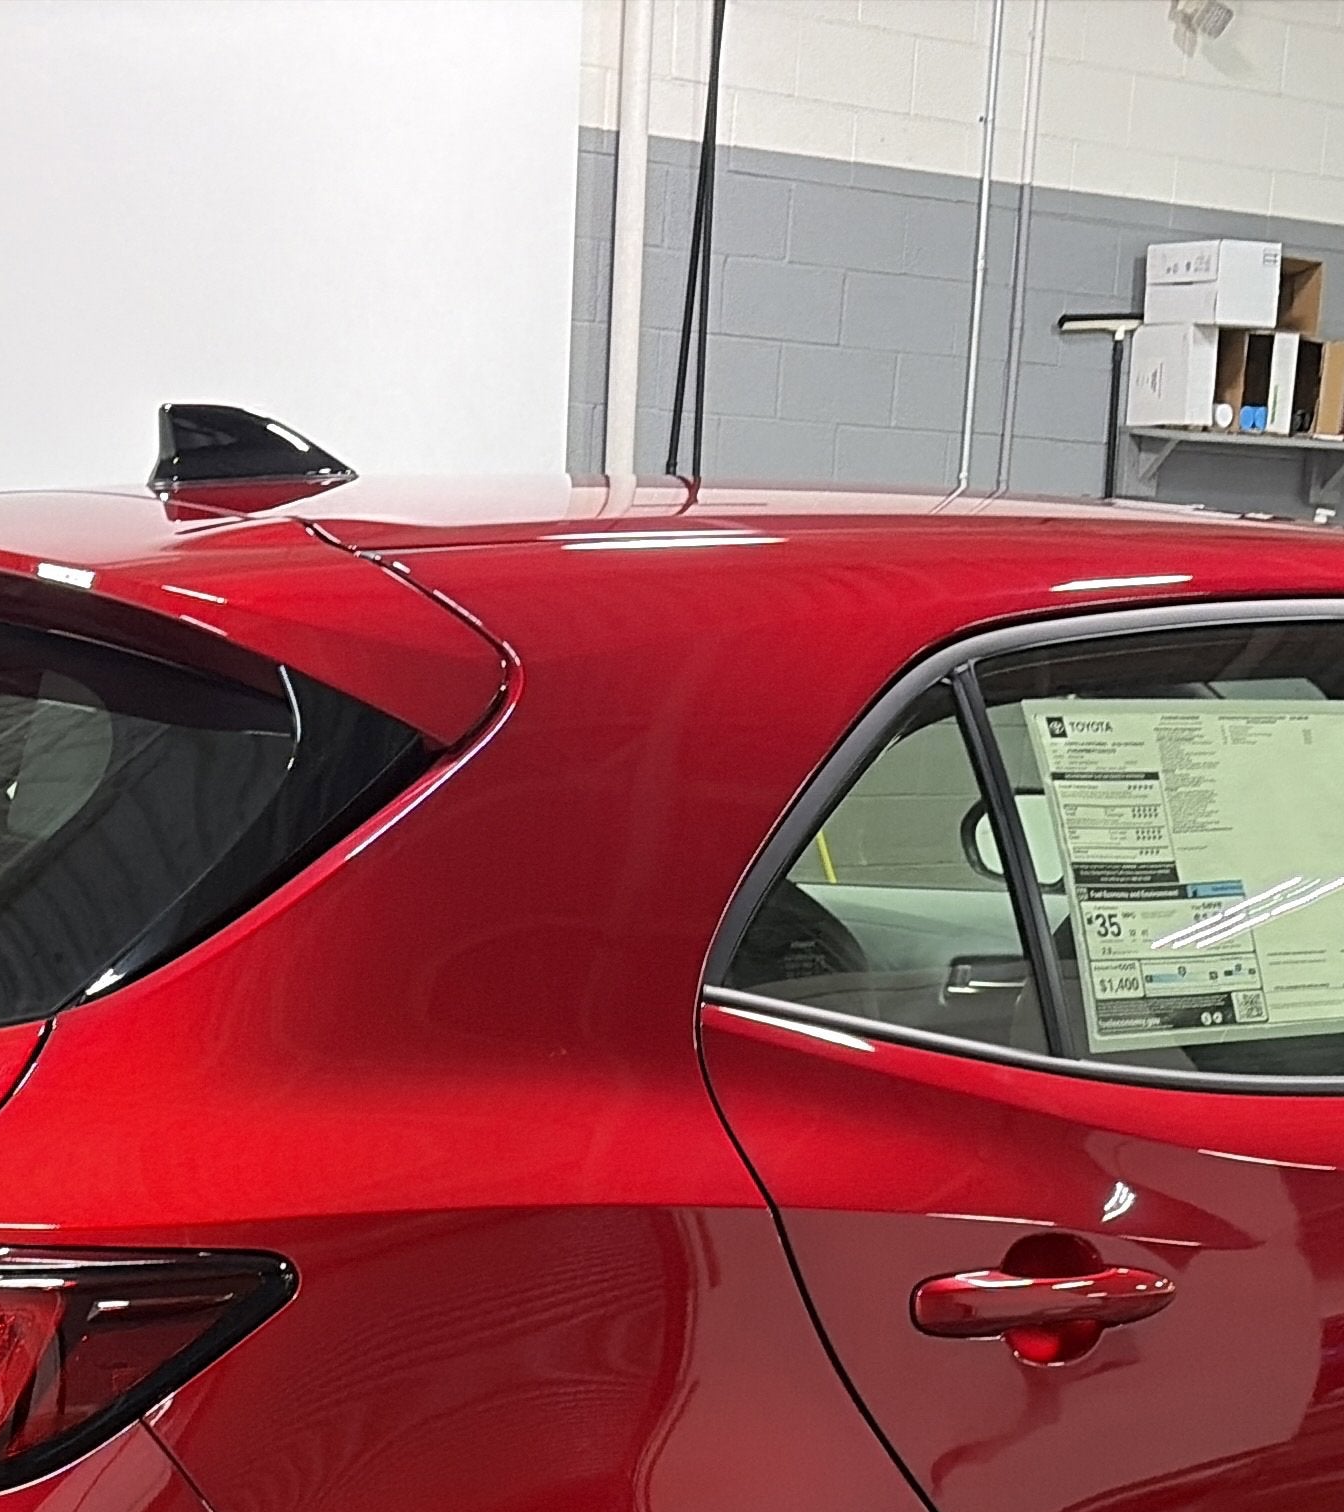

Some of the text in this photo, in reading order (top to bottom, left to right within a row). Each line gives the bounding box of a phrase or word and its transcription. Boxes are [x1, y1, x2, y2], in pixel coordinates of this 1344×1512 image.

[1068, 721, 1113, 733] TOYOTA
[1094, 913, 1122, 938] 35
[1099, 977, 1140, 993] $1,400
